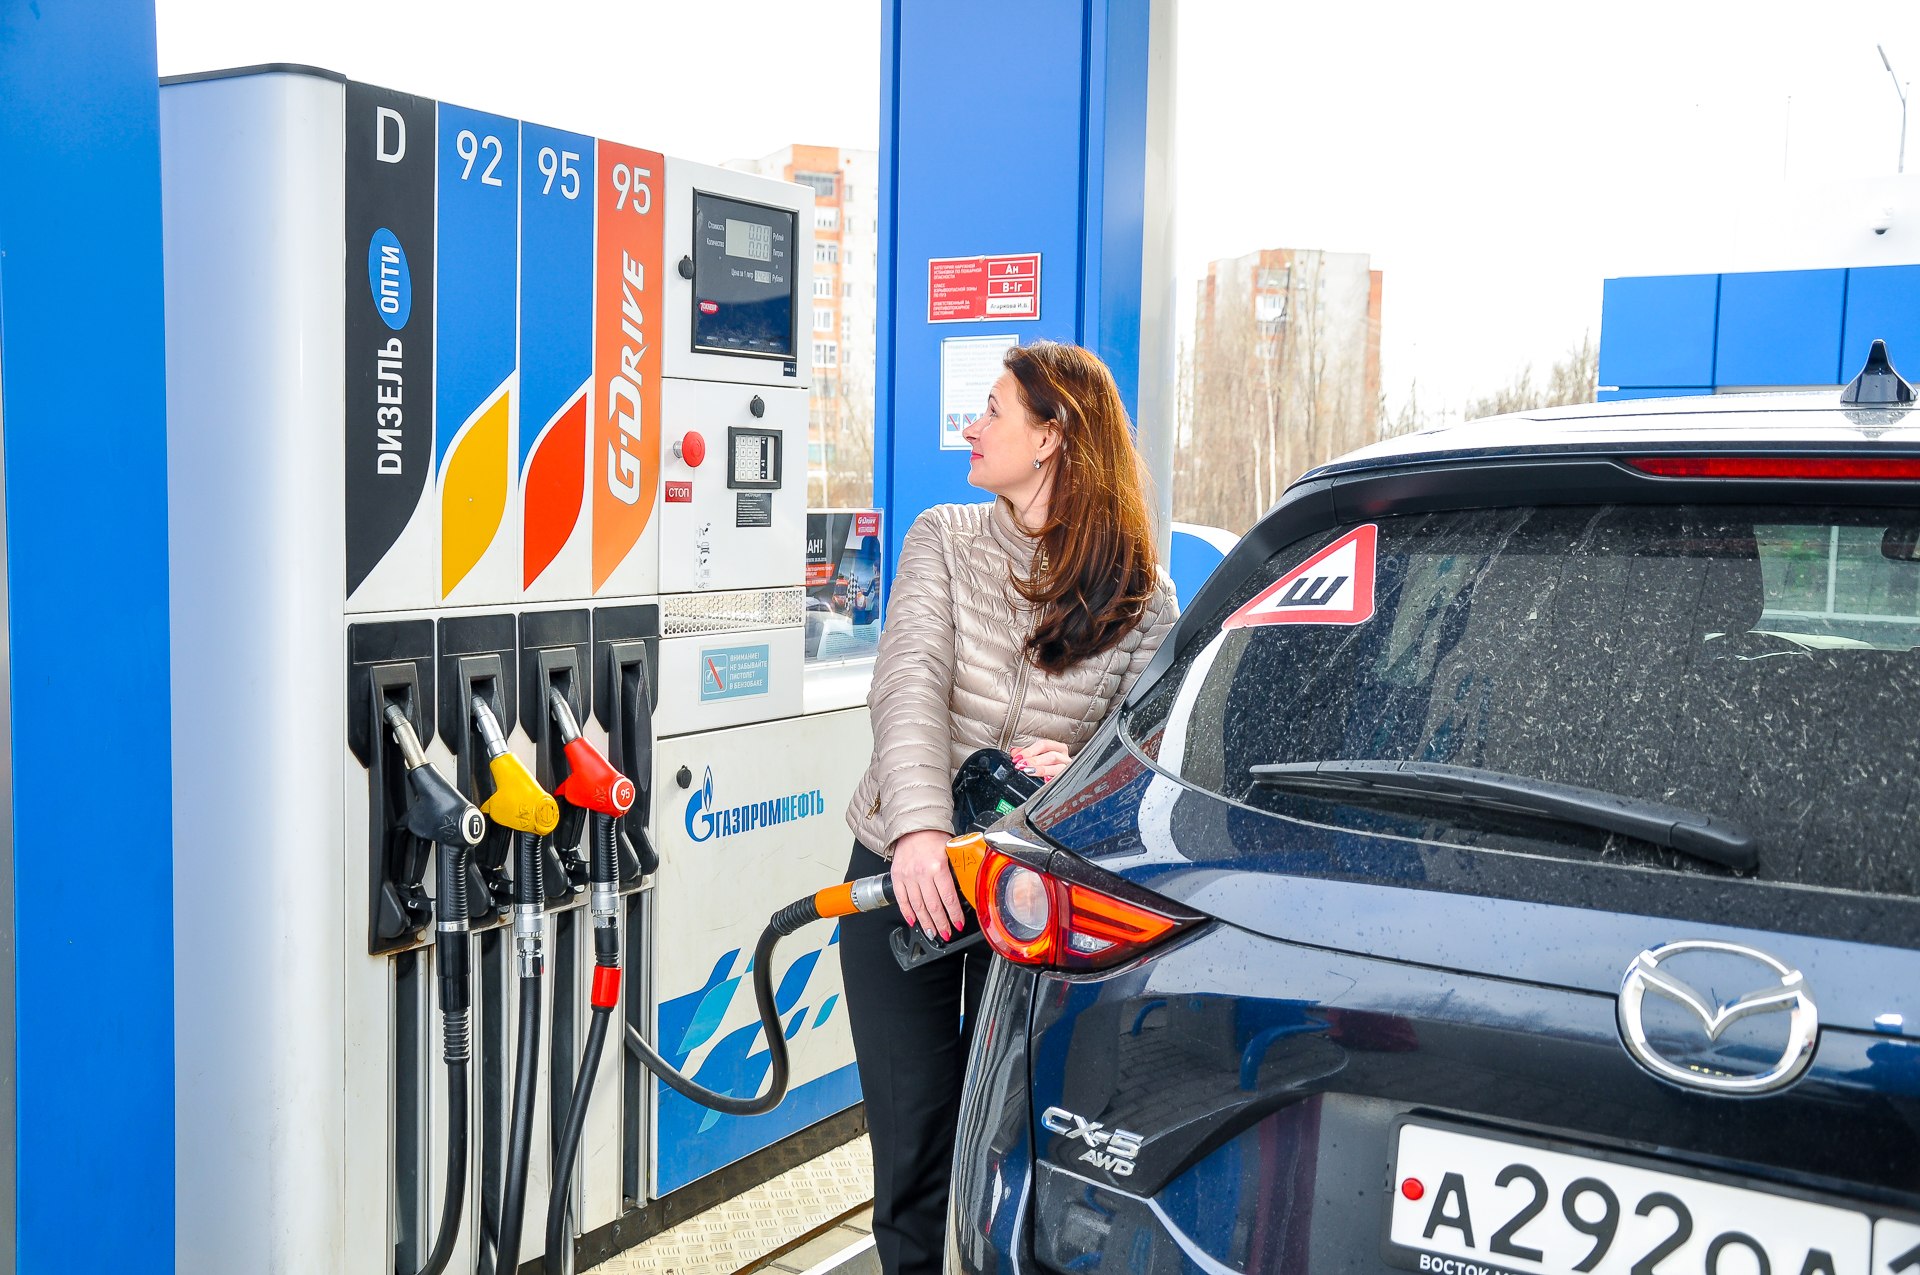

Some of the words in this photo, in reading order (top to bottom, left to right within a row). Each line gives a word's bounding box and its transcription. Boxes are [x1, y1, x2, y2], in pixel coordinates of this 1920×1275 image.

[376, 106, 406, 164] D
[456, 129, 503, 187] 92
[537, 146, 581, 200] 95
[612, 163, 651, 215] 95
[380, 245, 401, 314] ОПТИ
[668, 485, 690, 499] СТОП
[807, 538, 823, 554] АН!
[1276, 576, 1349, 607] Ш
[729, 652, 760, 662] ВНИМАНИЕ!
[729, 663, 737, 671] НЕ
[737, 659, 768, 670] ЗАБЫВАЙТЕ
[729, 670, 755, 681] ПИСТОЛЕТ
[733, 679, 763, 690] БЕНЗОБАКЕ
[620, 788, 631, 799] 95
[715, 789, 825, 839] ГАЗПРОМНЕФТЬ
[1041, 1106, 1145, 1160] CX-5
[1078, 1149, 1136, 1177] AWD
